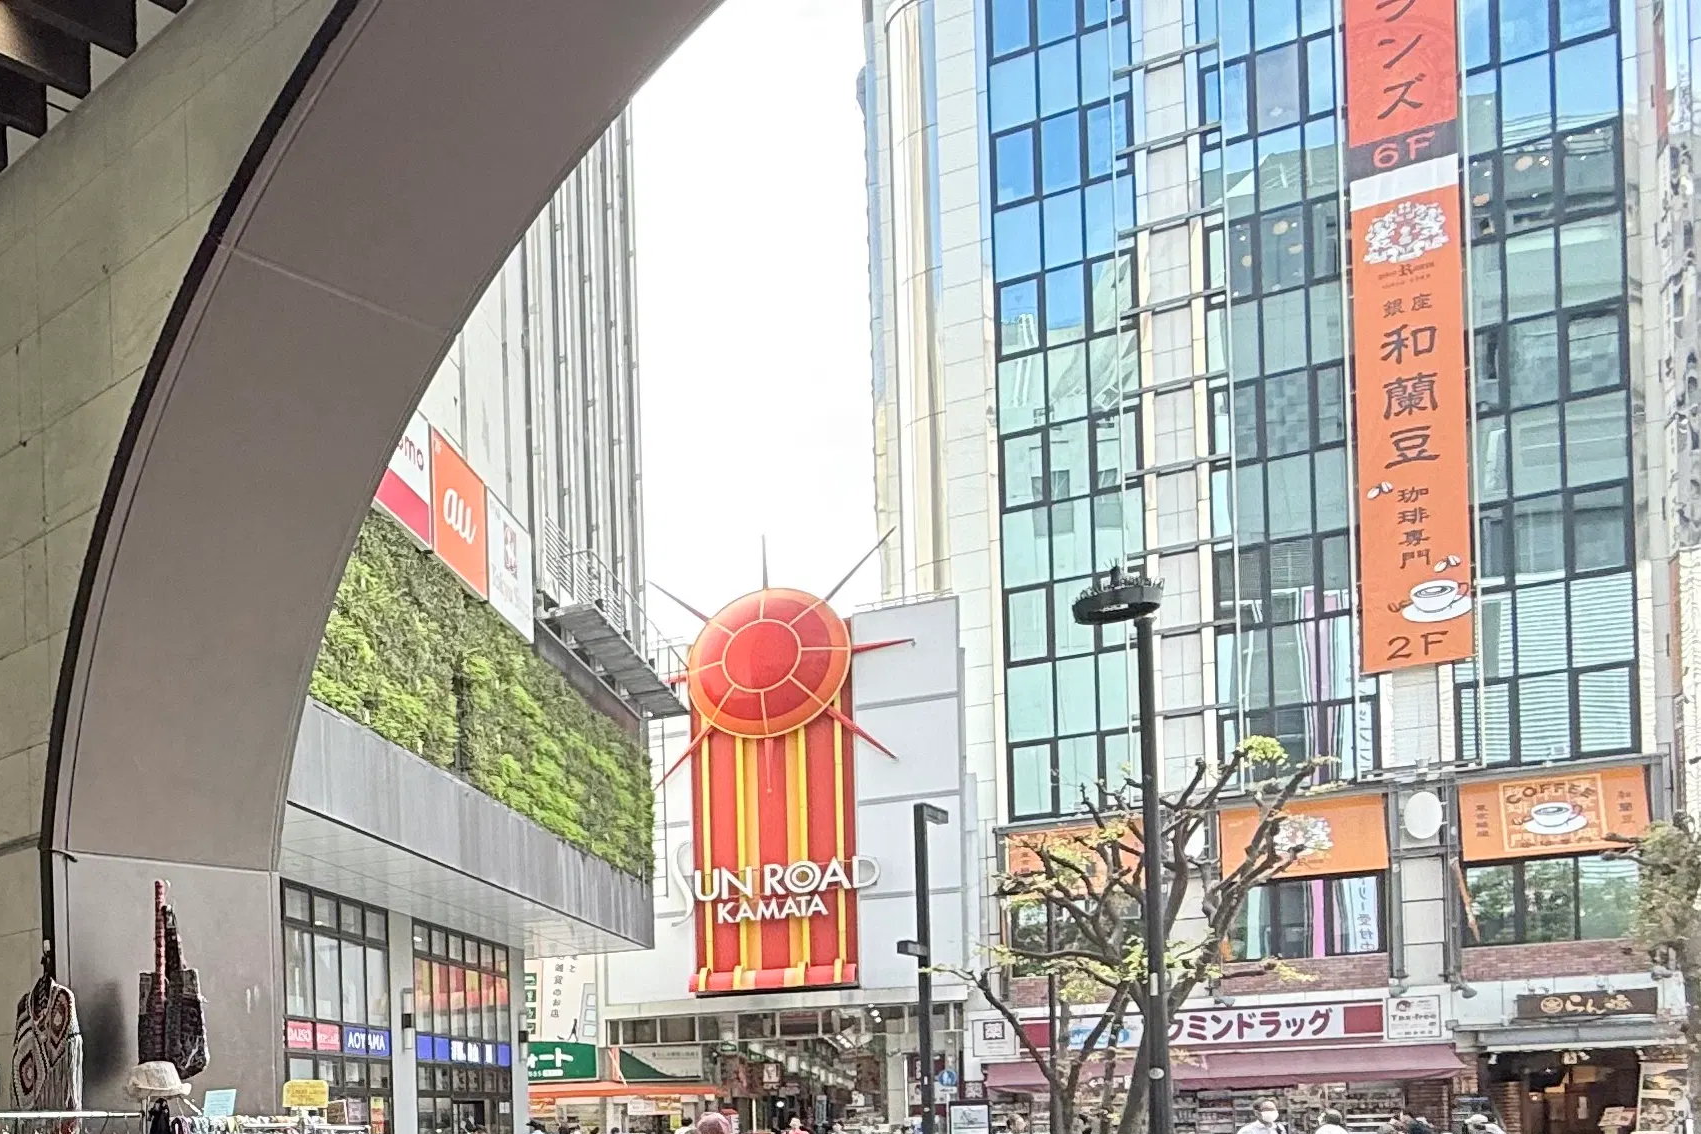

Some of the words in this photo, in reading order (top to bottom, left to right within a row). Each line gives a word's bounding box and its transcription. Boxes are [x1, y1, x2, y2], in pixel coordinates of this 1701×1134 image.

[1373, 131, 1436, 168] 6F
[1383, 293, 1432, 318] 銀座
[1380, 324, 1441, 469] 和蘭豆
[443, 488, 477, 545] au
[1386, 630, 1449, 661] 2F
[1506, 783, 1596, 804] COFFEE
[671, 841, 754, 927] SUN
[763, 855, 881, 896] ROAD
[717, 894, 829, 924] KAMATA
[347, 1031, 386, 1051] AOYAMA
